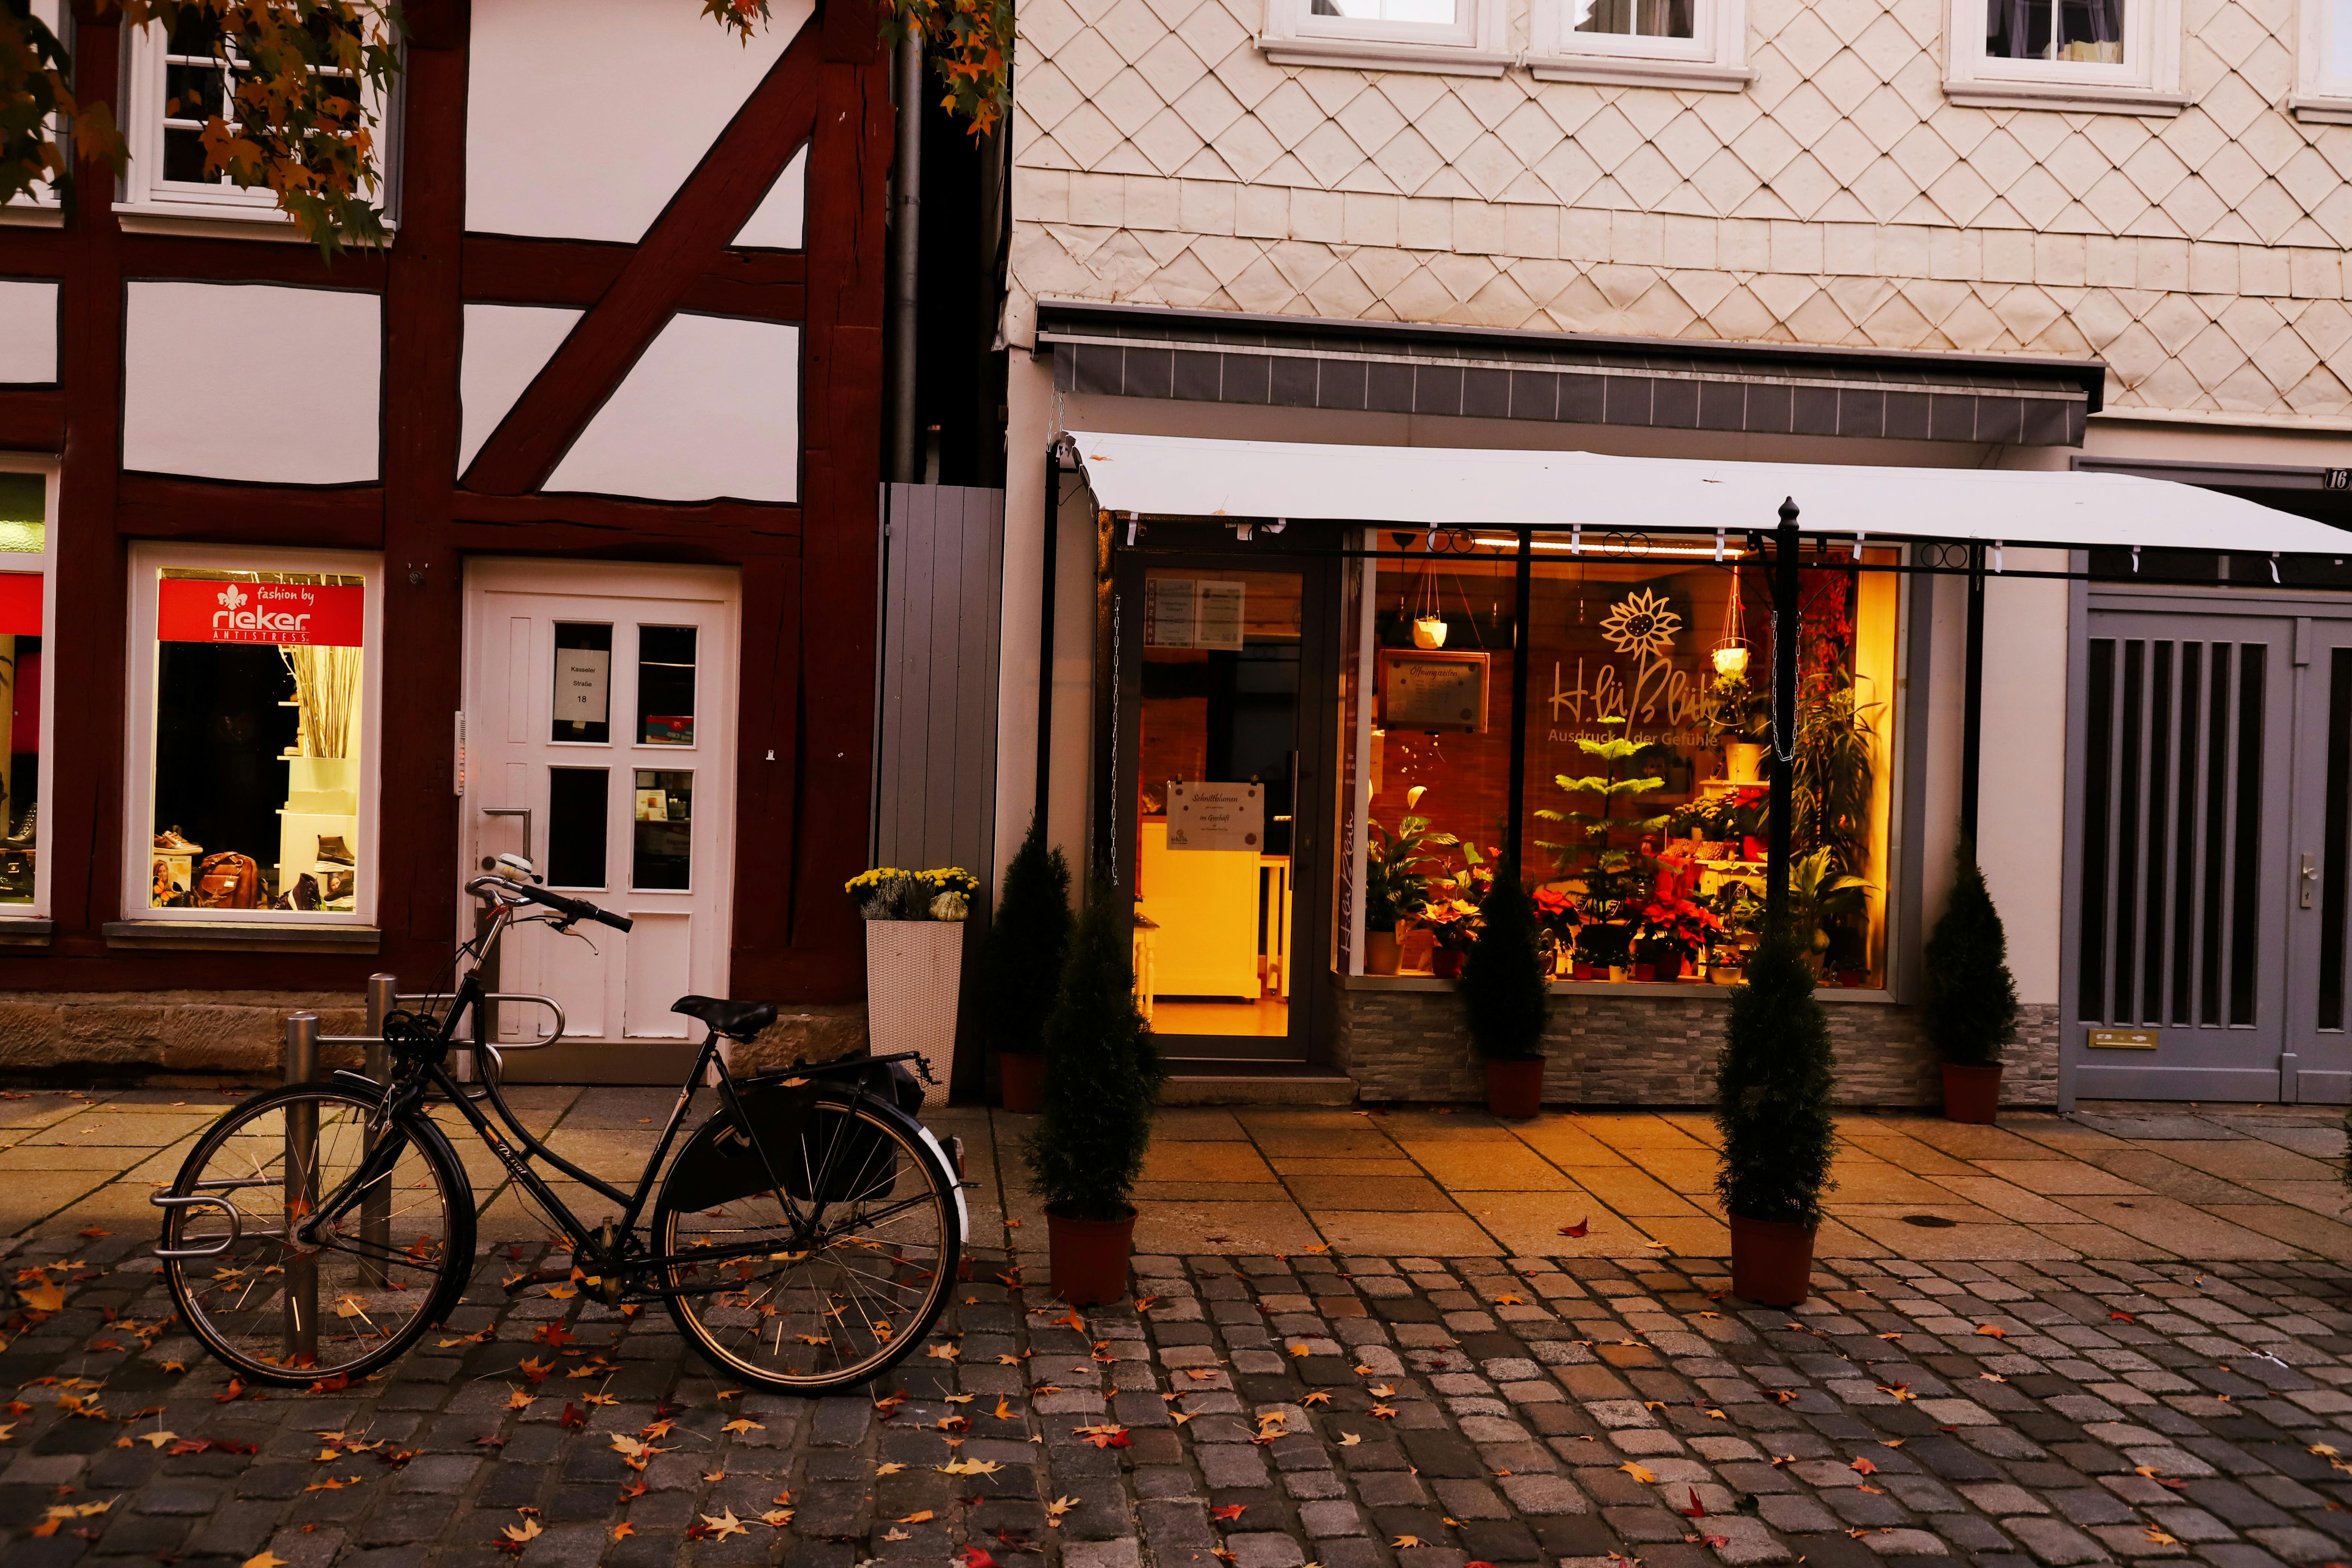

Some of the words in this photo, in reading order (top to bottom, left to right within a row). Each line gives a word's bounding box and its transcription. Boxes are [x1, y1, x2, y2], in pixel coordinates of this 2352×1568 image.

[2329, 471, 2347, 488] 16
[257, 586, 297, 600] fashion
[302, 588, 314, 606] by
[213, 605, 310, 631] rieker
[213, 631, 305, 642] ANTISTRESS
[1410, 666, 1457, 680] Öffnungszeiten
[1634, 731, 1657, 744] der
[1661, 732, 1718, 746] Gefühle
[1192, 793, 1238, 802] Schnittblumen
